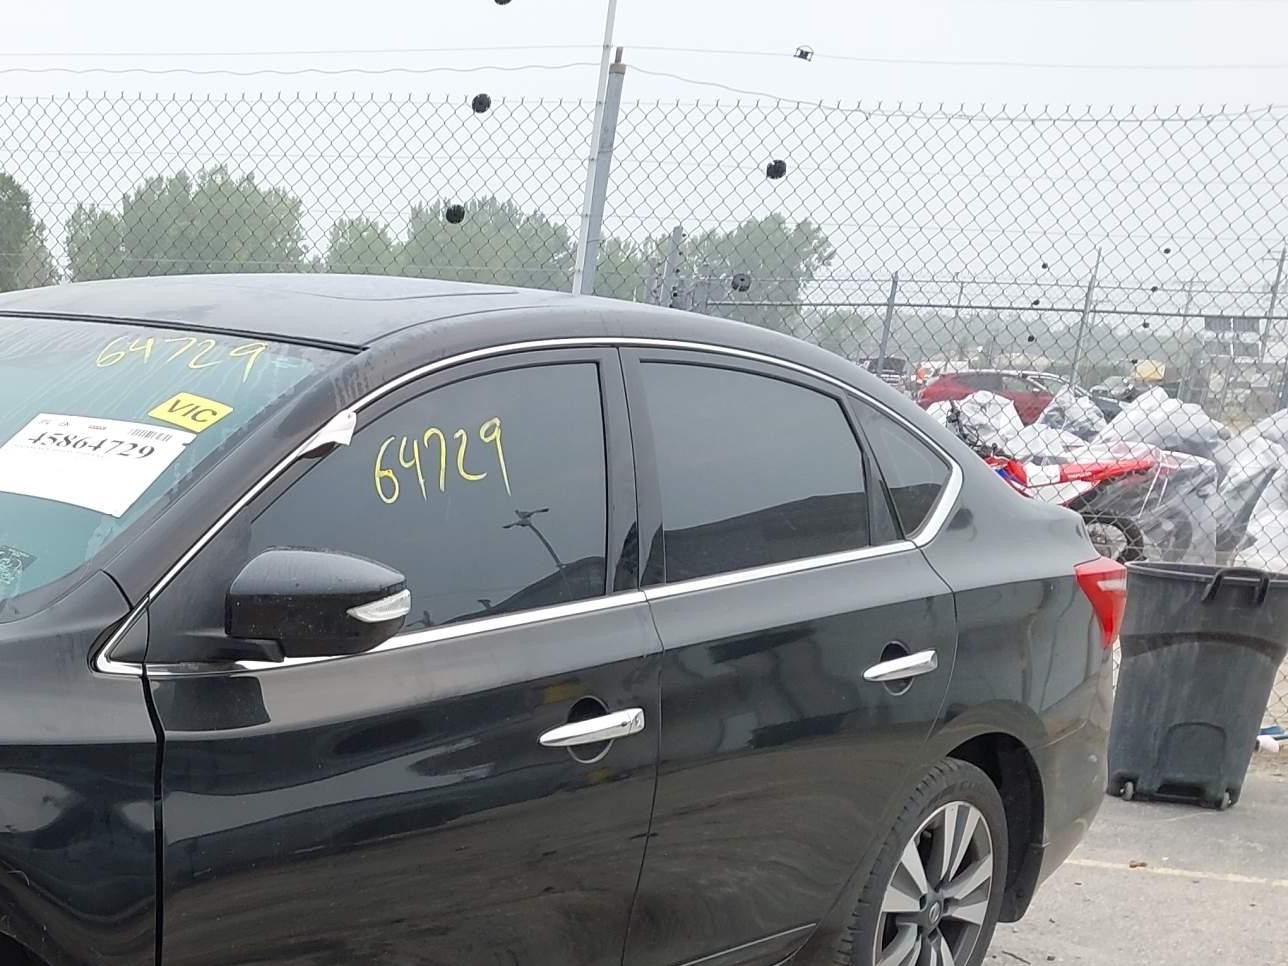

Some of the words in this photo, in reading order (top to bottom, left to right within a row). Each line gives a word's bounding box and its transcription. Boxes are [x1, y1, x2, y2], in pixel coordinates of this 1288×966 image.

[96, 335, 269, 384] 64729
[167, 399, 218, 423] VIC
[28, 431, 156, 459] 45864729
[375, 416, 512, 504] 64729
